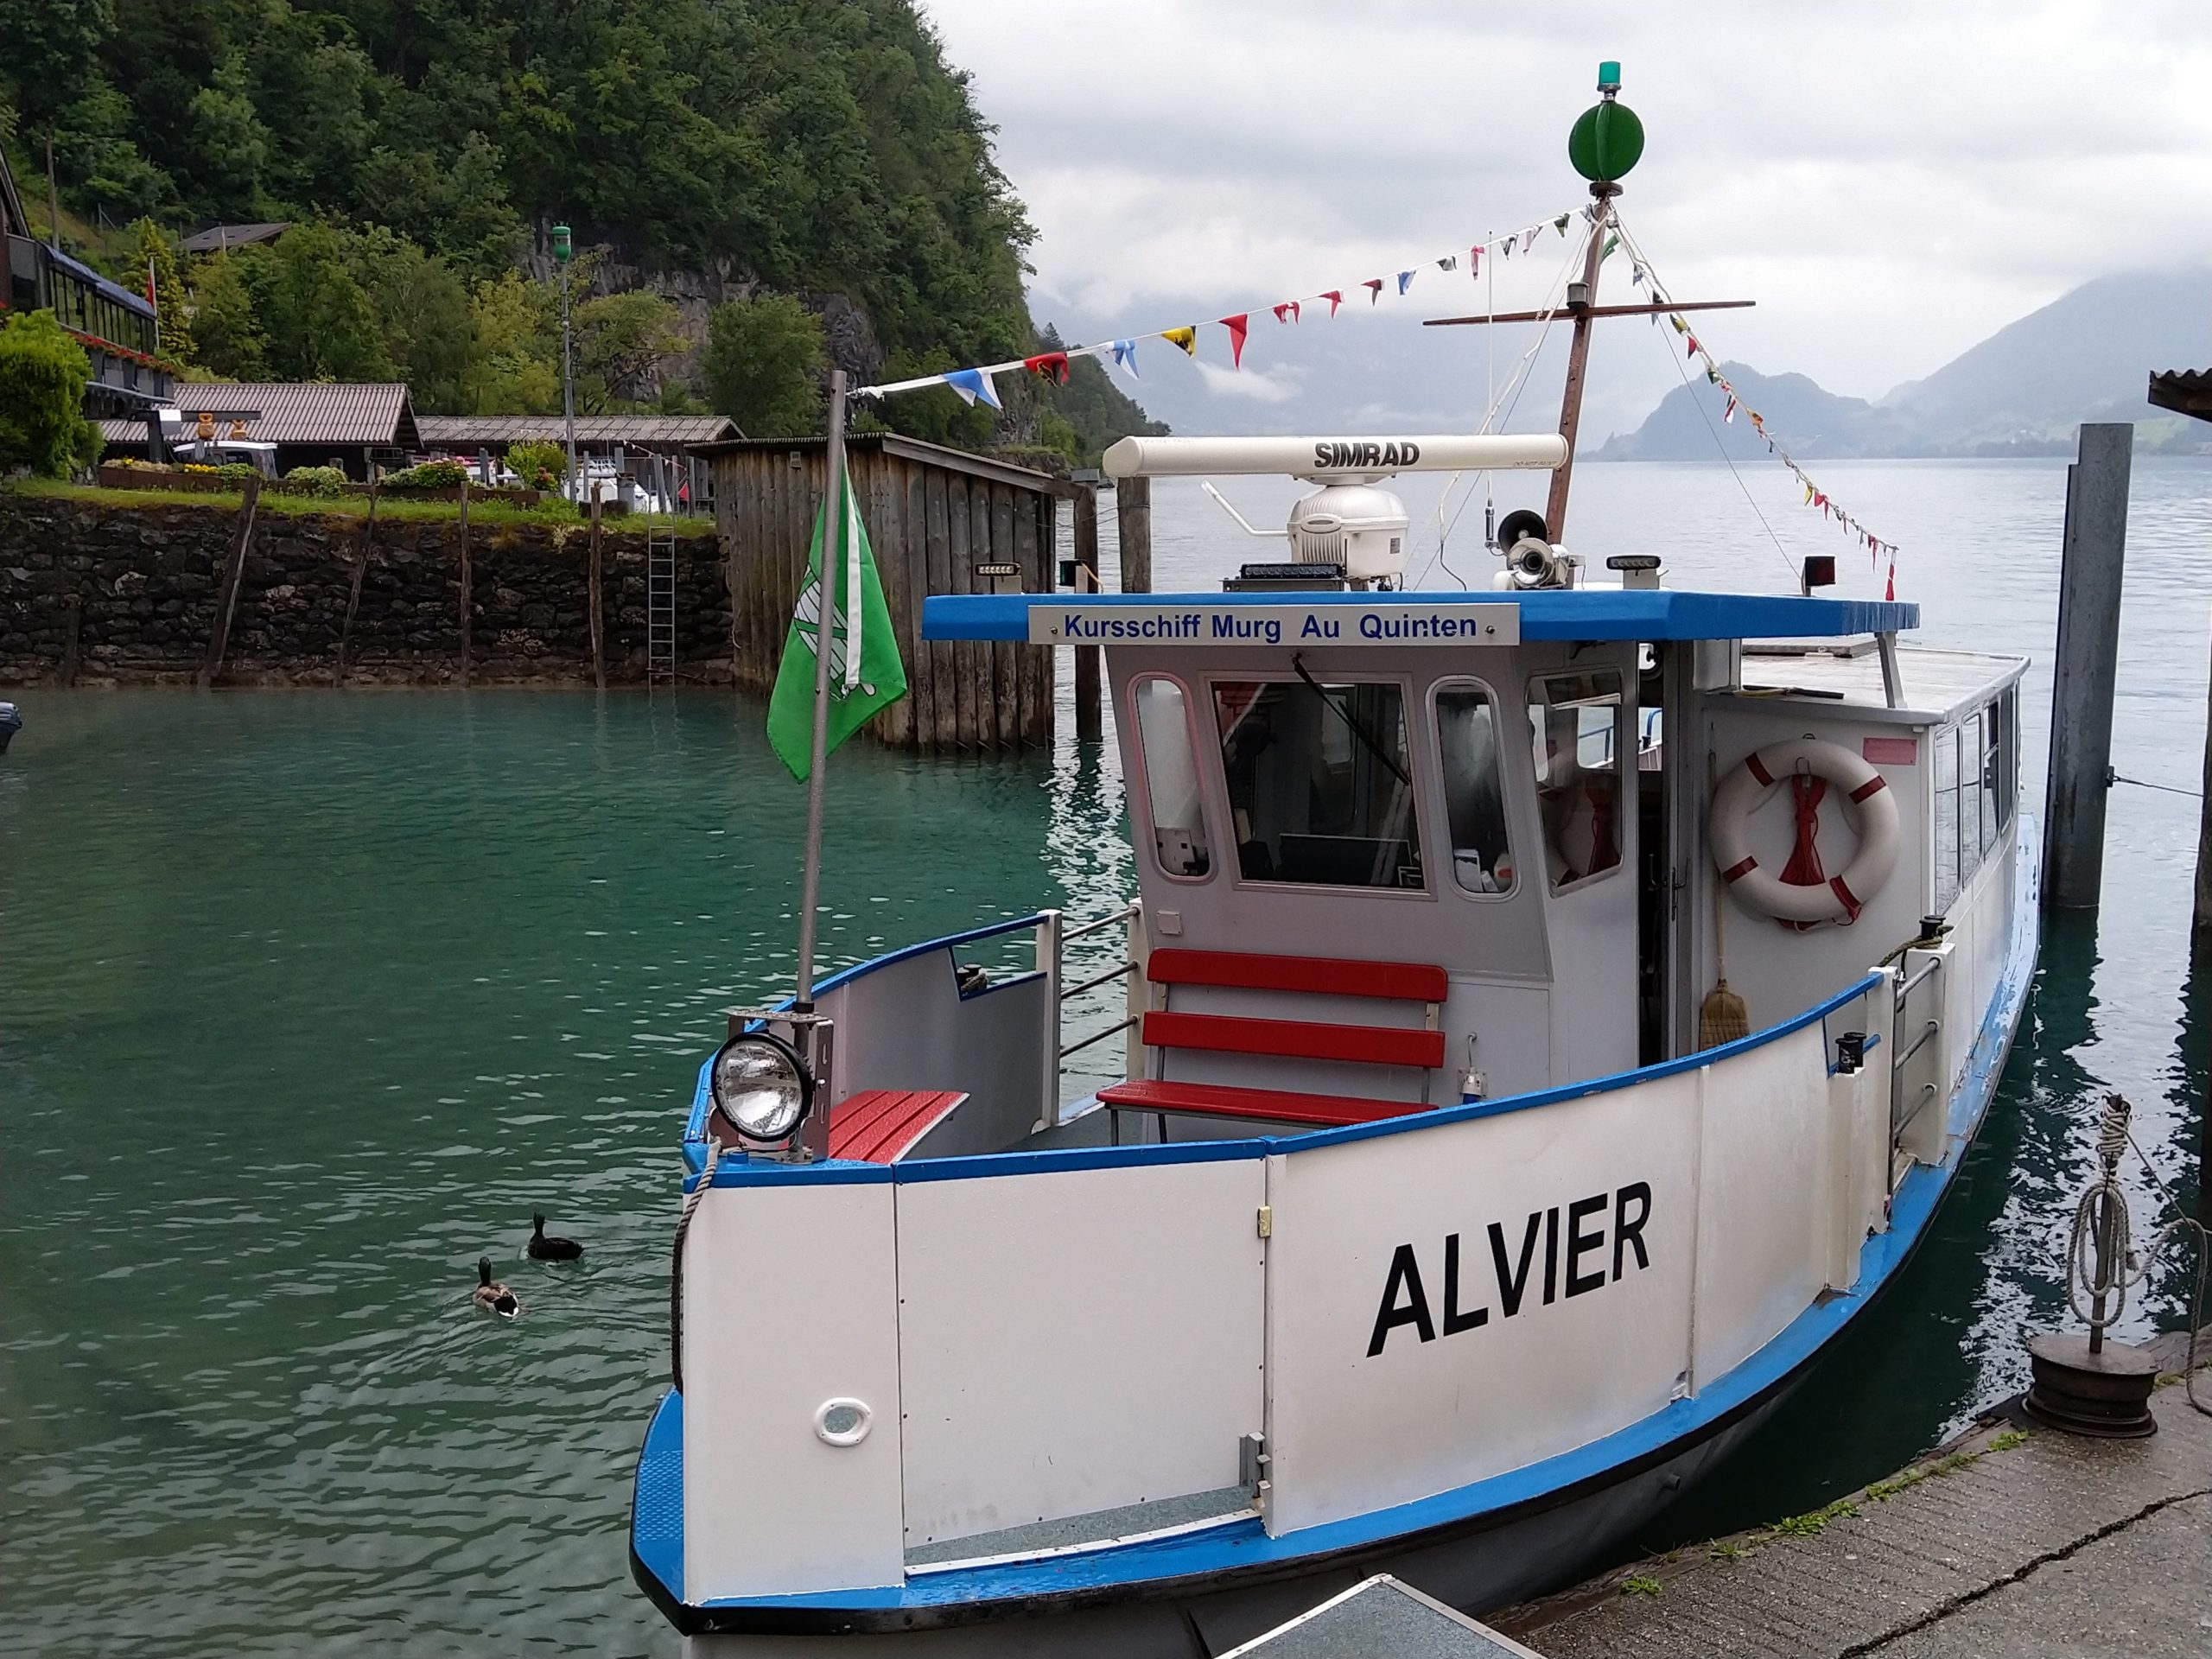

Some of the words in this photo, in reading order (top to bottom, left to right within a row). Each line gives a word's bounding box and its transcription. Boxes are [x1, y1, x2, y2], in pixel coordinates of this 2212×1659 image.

[1314, 442, 1420, 467] SIMRAD
[1064, 613, 1201, 639] Kursschiff
[1211, 614, 1281, 643] Murg
[1300, 614, 1340, 639] Au
[1359, 613, 1477, 639] Quinten
[1366, 1181, 1651, 1357] ALVIER
